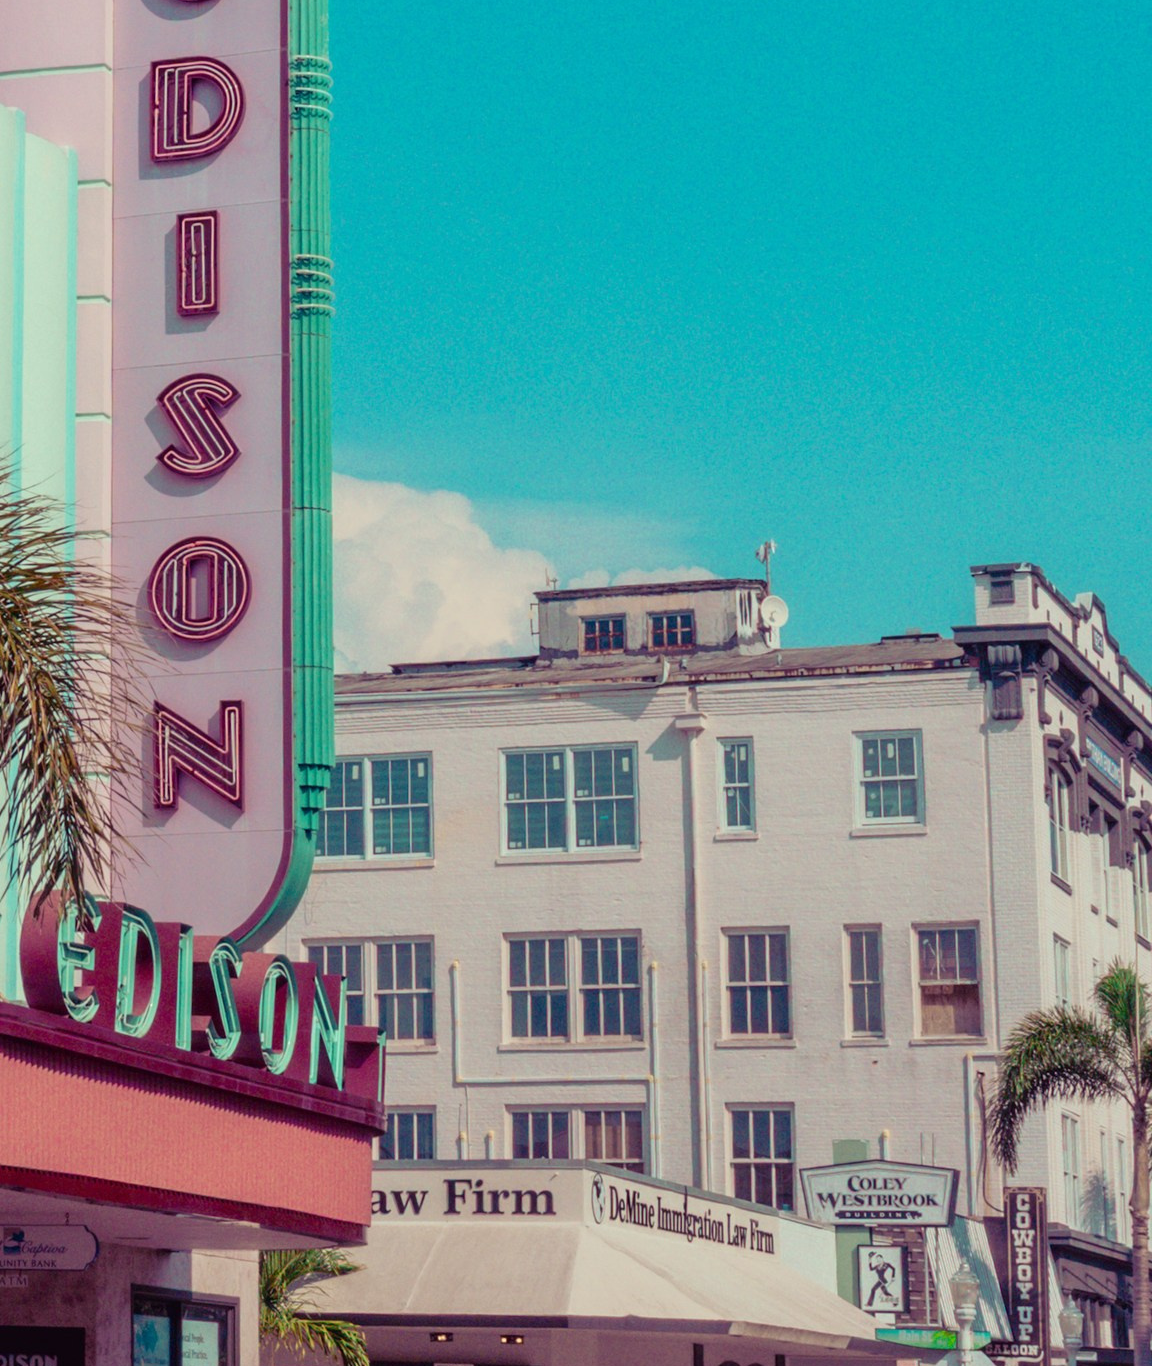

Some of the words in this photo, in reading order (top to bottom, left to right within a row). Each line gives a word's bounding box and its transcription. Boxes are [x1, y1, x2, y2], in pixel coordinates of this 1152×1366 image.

[28, 889, 348, 1091] EDISON
[847, 1175, 907, 1192] COLEY
[370, 1189, 429, 1215] aw
[443, 1178, 557, 1215] Firm
[816, 1192, 939, 1210] WESTBROOK
[609, 1185, 655, 1229] DeMine
[657, 1196, 724, 1243] Immigration
[727, 1213, 747, 1249] Law
[750, 1219, 775, 1255] Firm
[21, 1240, 67, 1257] Captiva
[1012, 1193, 1035, 1300] COWBOY
[31, 1260, 57, 1268] BANK
[0, 1275, 27, 1285] ATM
[1016, 1306, 1034, 1341] UP
[985, 1344, 1039, 1356] SALOON
